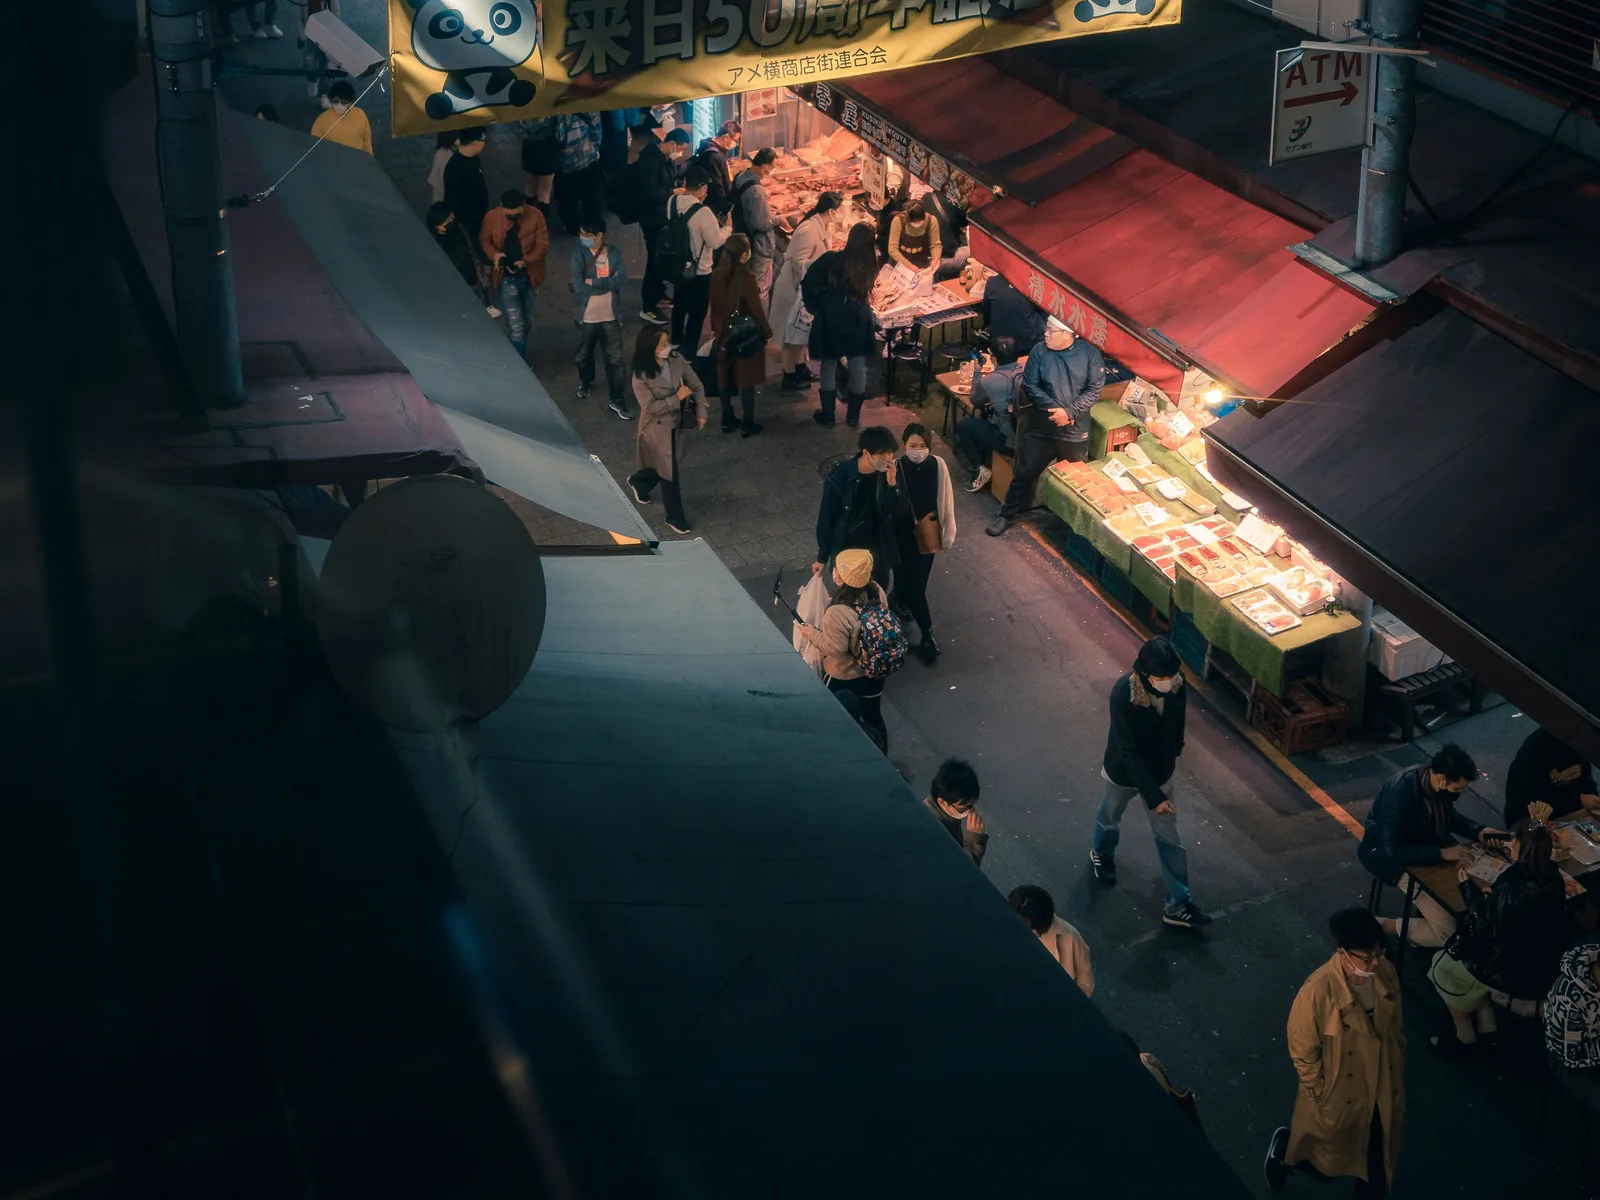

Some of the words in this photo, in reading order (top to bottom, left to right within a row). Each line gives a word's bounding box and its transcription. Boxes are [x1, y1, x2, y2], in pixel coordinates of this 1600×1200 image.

[727, 45, 888, 86] アメ横商店街連合会
[1285, 52, 1362, 89] ATM
[795, 81, 859, 131] 香屋
[1027, 269, 1108, 350] 清水水産
